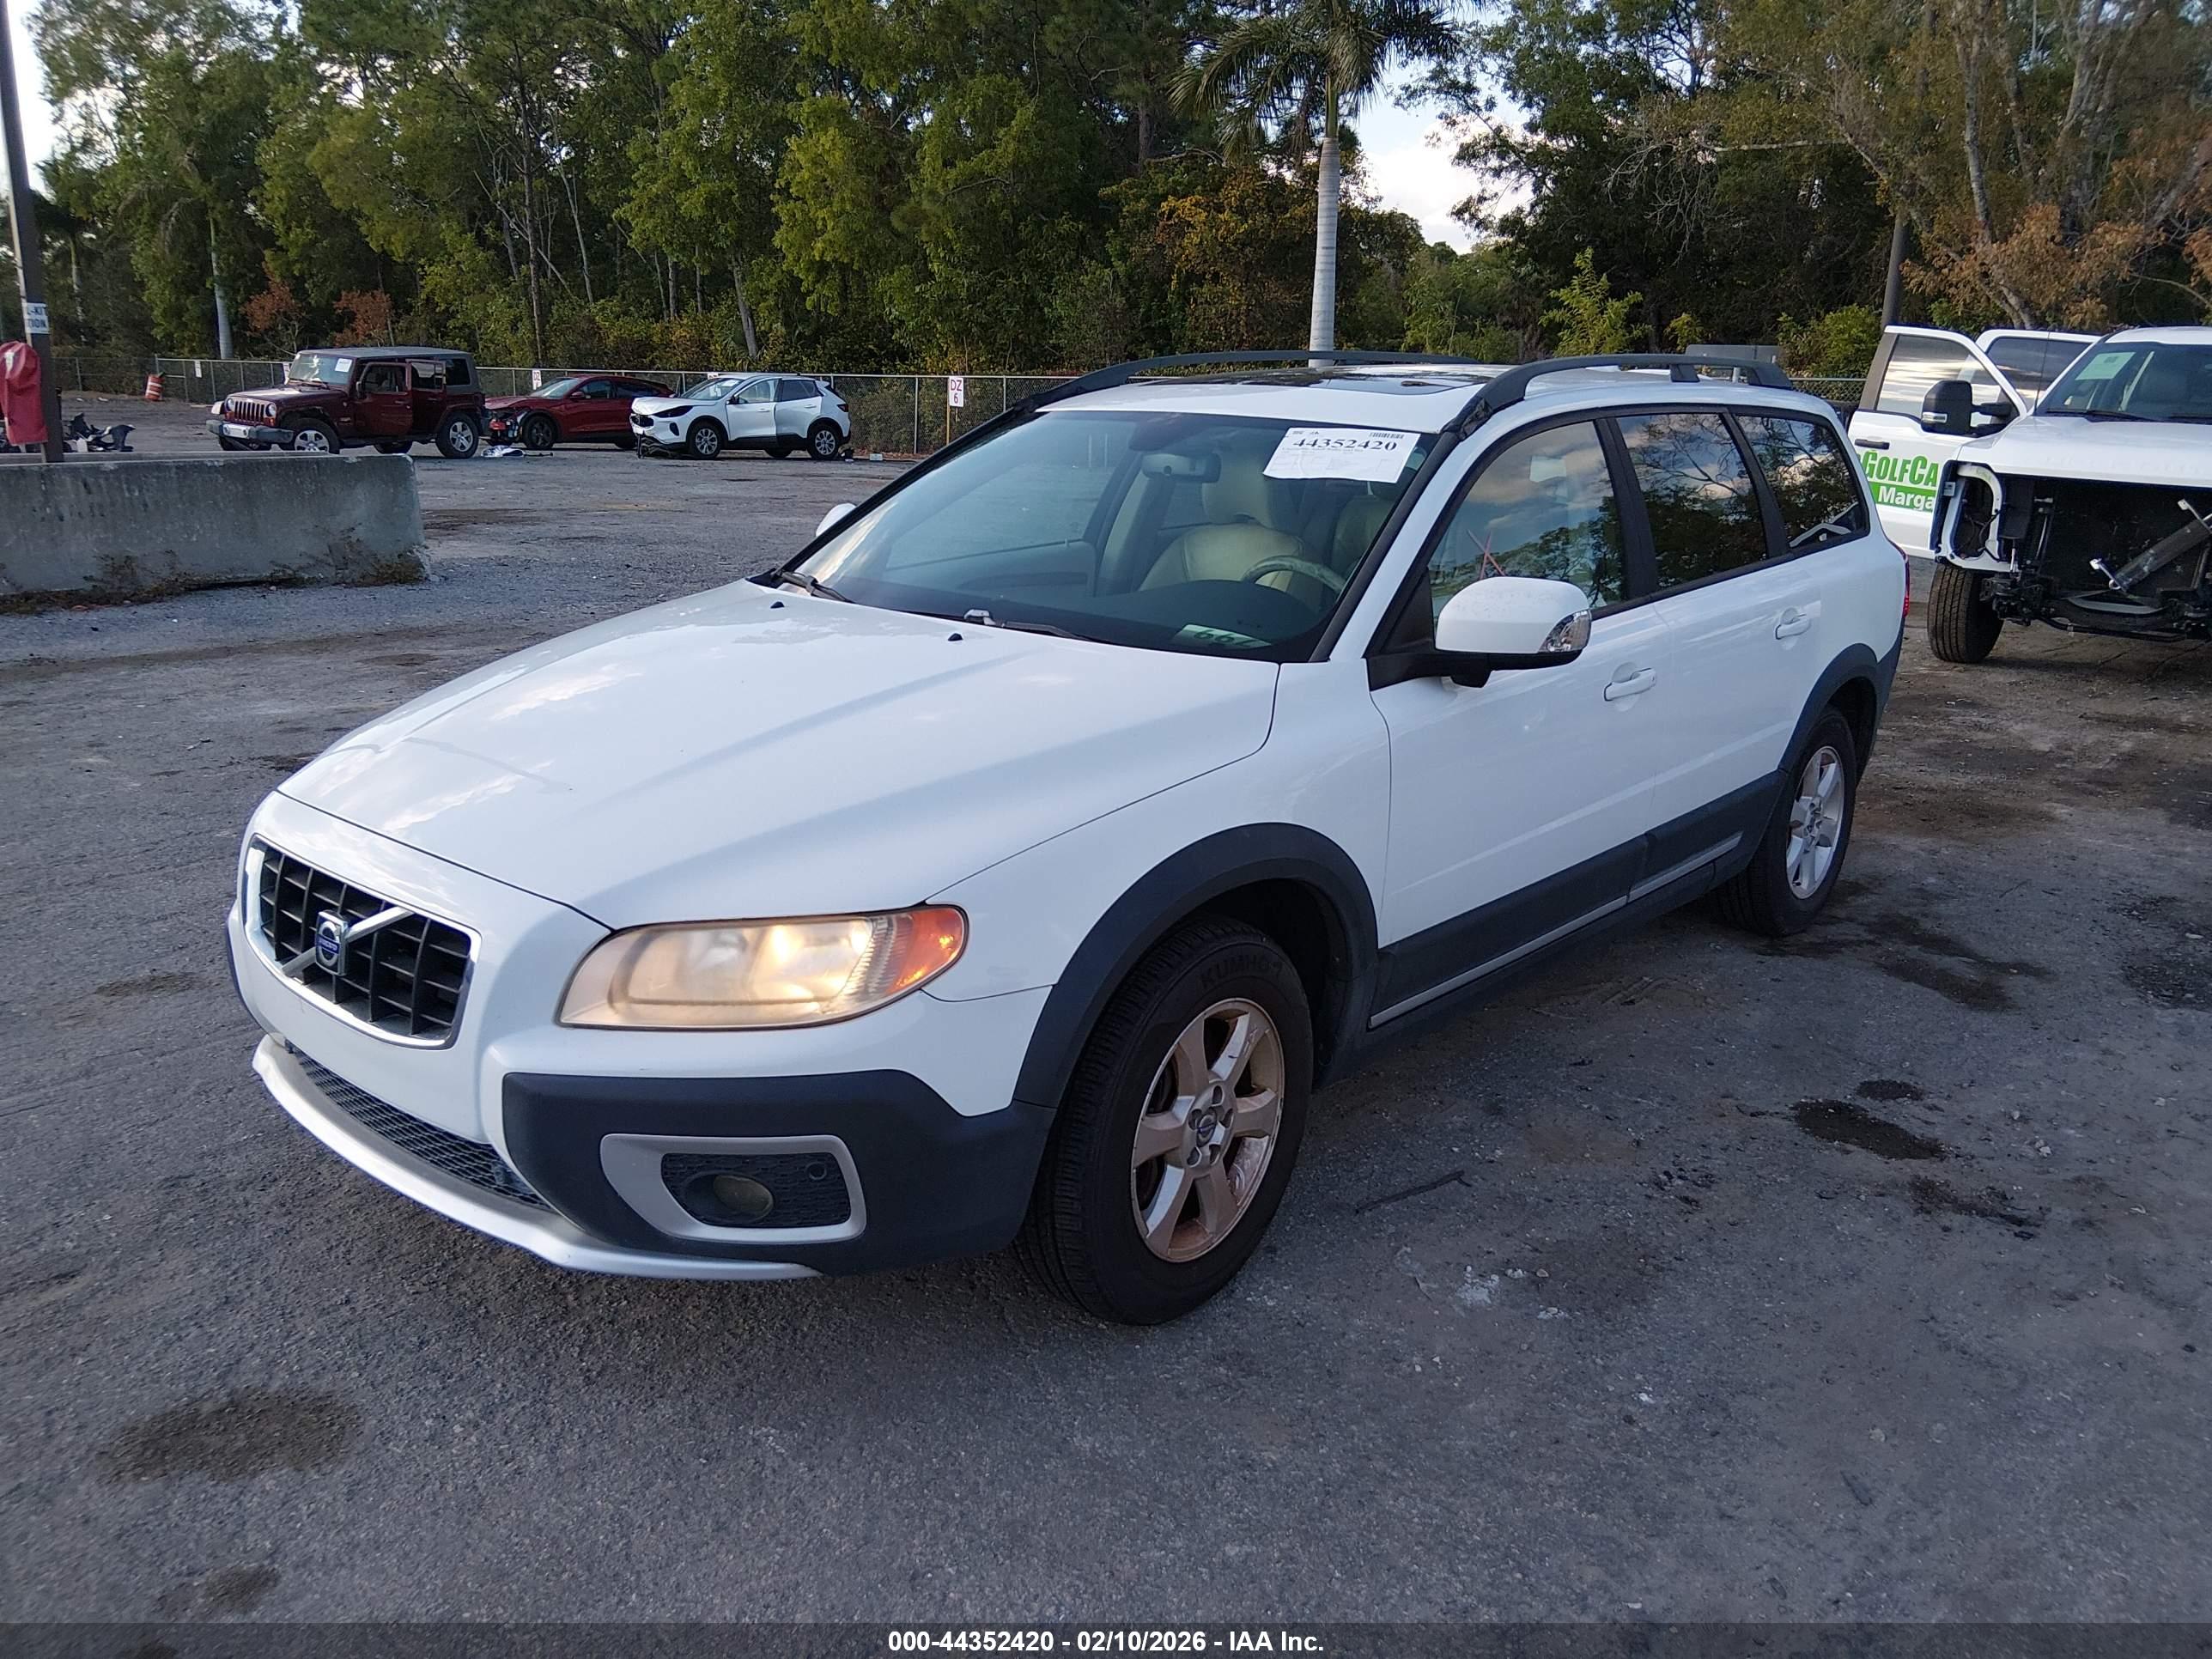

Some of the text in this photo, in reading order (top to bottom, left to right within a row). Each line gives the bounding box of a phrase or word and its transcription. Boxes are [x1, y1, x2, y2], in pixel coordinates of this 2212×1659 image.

[951, 379, 963, 392] DZ
[953, 393, 958, 404] 6
[1292, 438, 1398, 451] 44352420
[1858, 451, 1939, 487] GOLFCA
